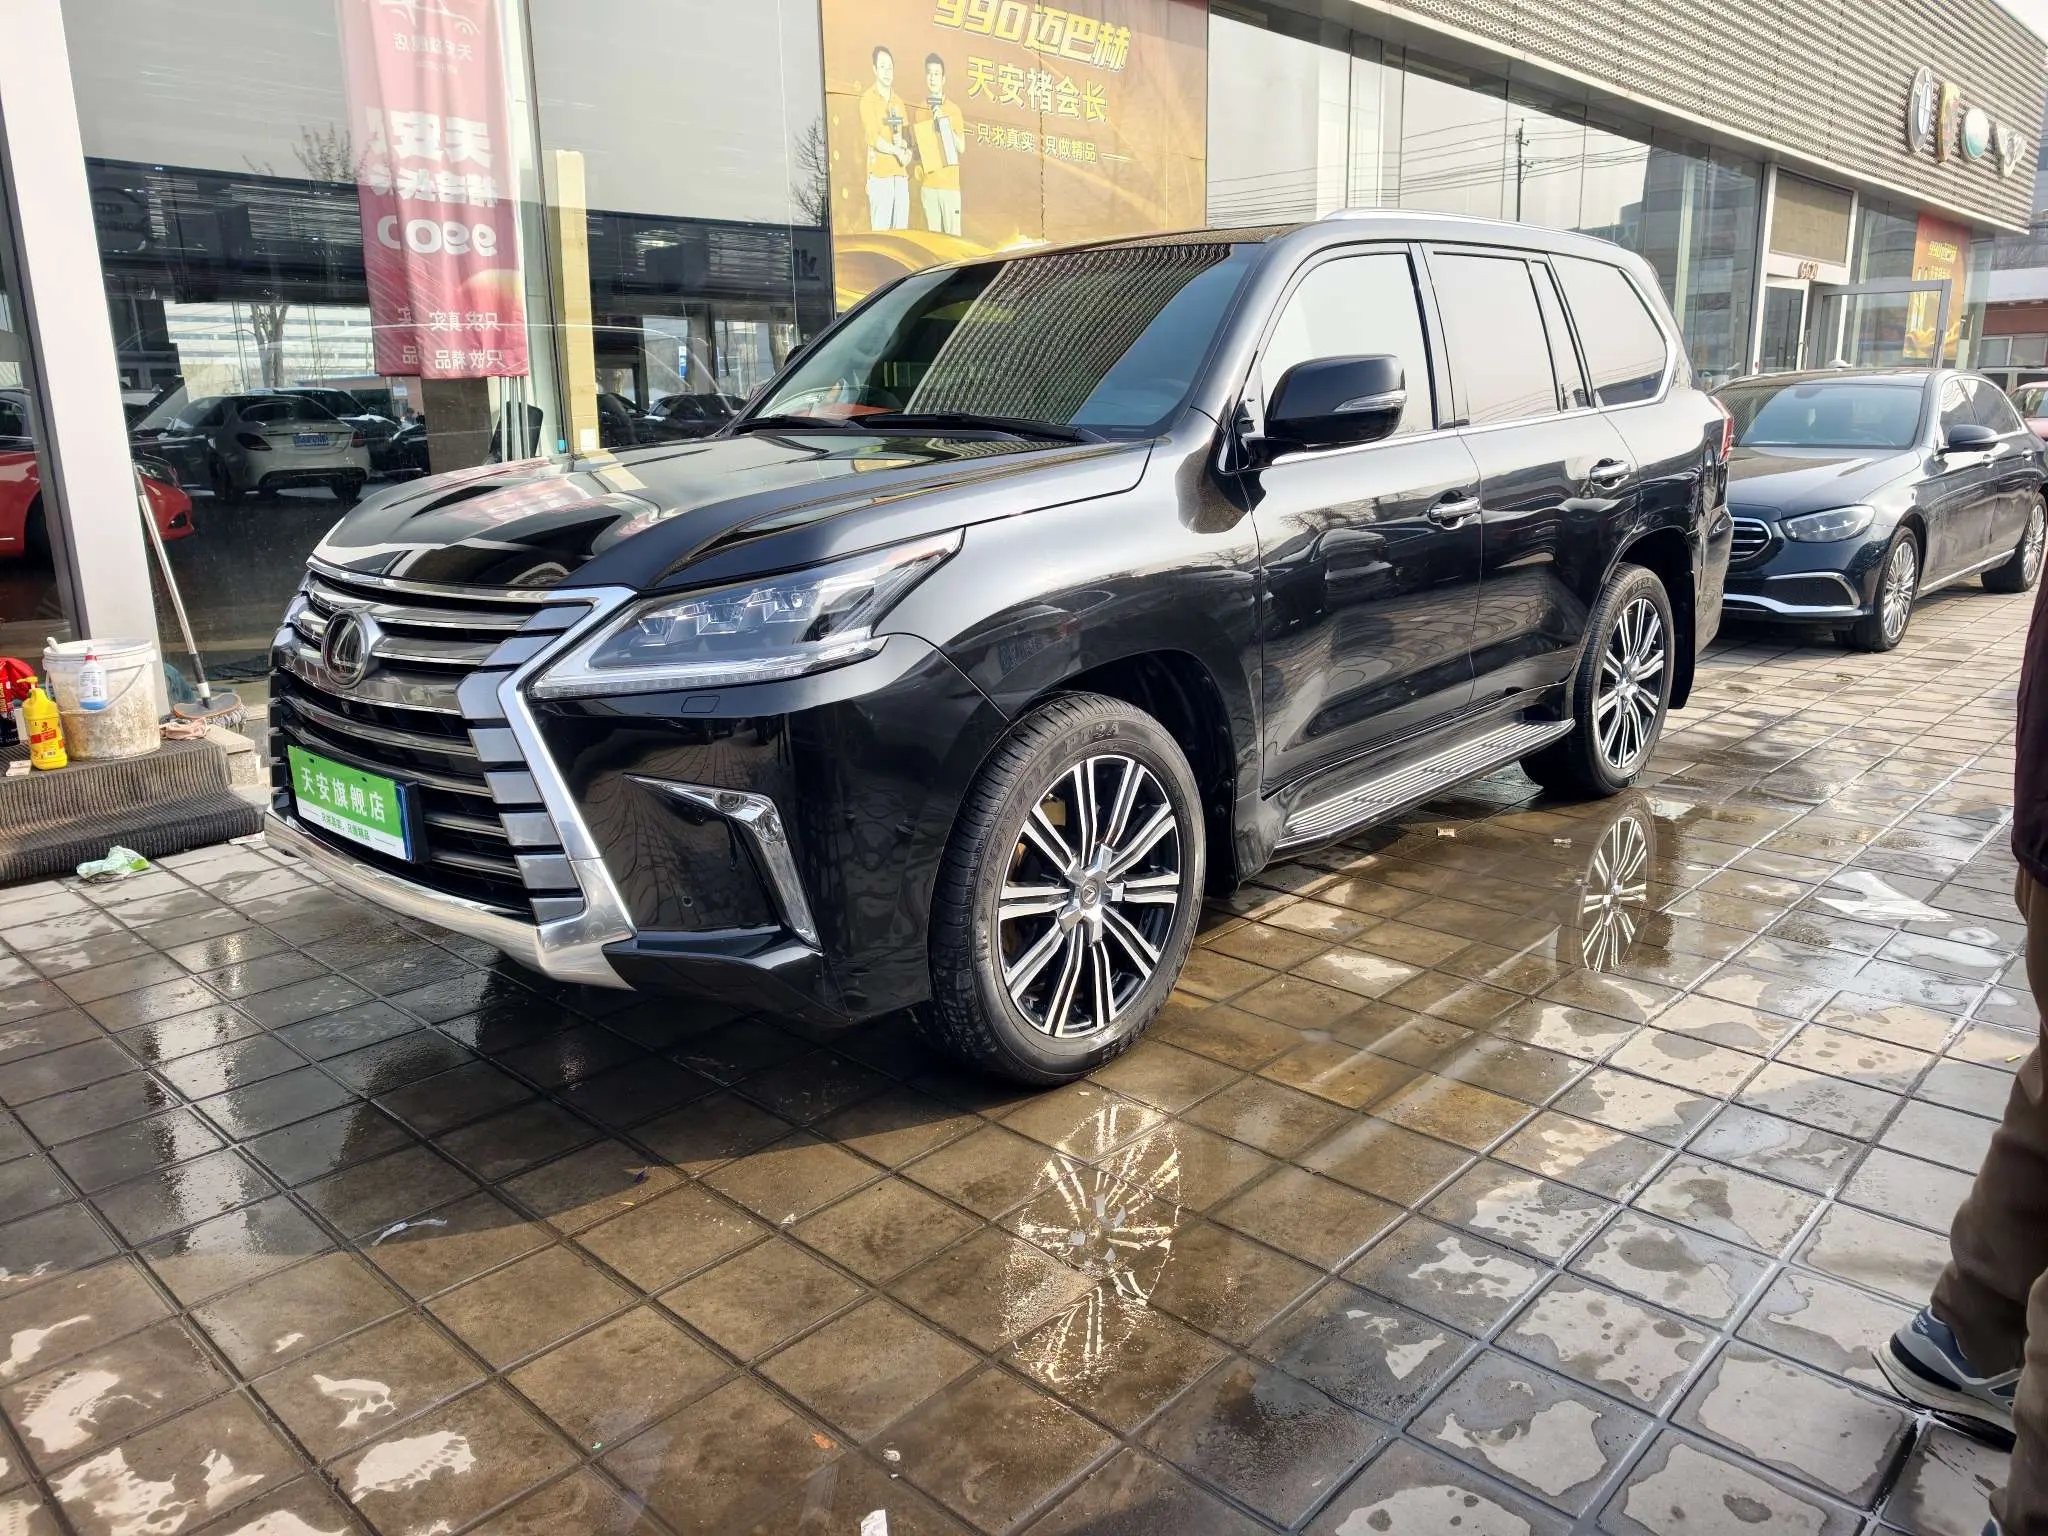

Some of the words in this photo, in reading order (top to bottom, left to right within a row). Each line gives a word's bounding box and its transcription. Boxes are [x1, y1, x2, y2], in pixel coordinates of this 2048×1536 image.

[933, 0, 1131, 72] 990迈巴赫
[967, 56, 1108, 122] 天安褚会长
[977, 123, 1036, 153] 只求真实
[1046, 135, 1098, 163] 只做精品
[301, 767, 386, 824] 天安旗舰店
